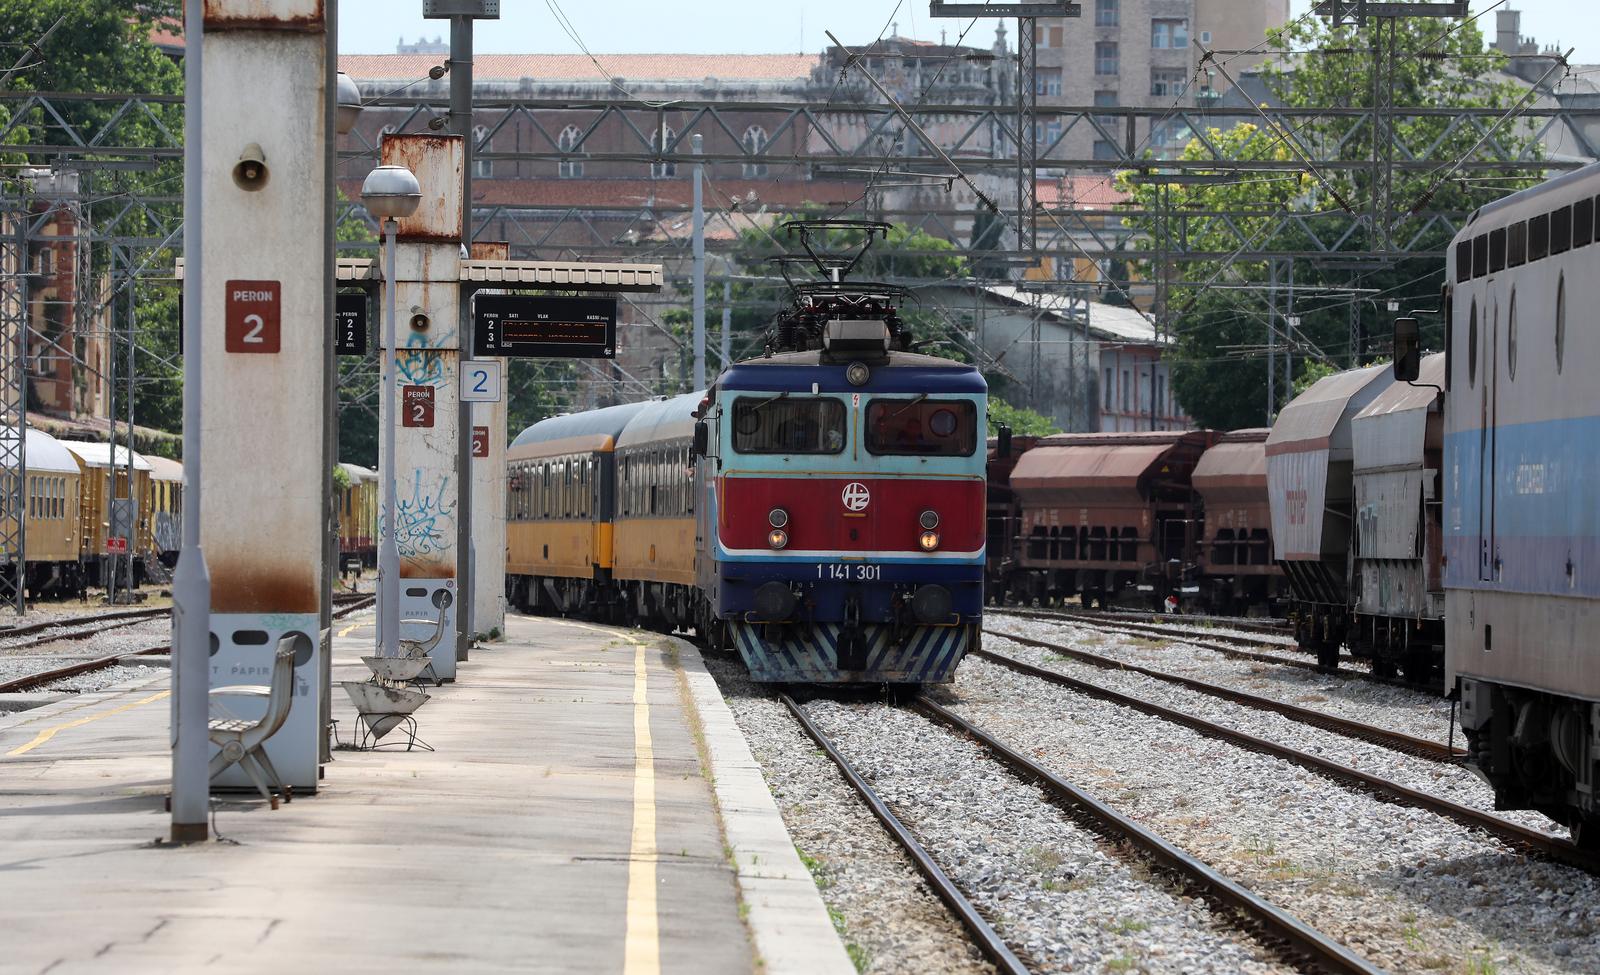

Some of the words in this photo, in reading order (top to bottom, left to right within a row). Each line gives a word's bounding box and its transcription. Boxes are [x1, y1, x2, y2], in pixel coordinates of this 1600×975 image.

[233, 290, 273, 302] PERON
[243, 313, 264, 343] 2
[347, 318, 354, 328] 2
[487, 320, 495, 330] 2
[347, 331, 354, 341] 2
[487, 332, 495, 342] 3
[472, 370, 488, 393] 2
[412, 404, 425, 422] 2
[472, 440, 482, 453] 2
[816, 563, 823, 579] 1
[828, 563, 850, 580] 141
[856, 564, 881, 580] 301
[231, 666, 271, 675] PAPIR
